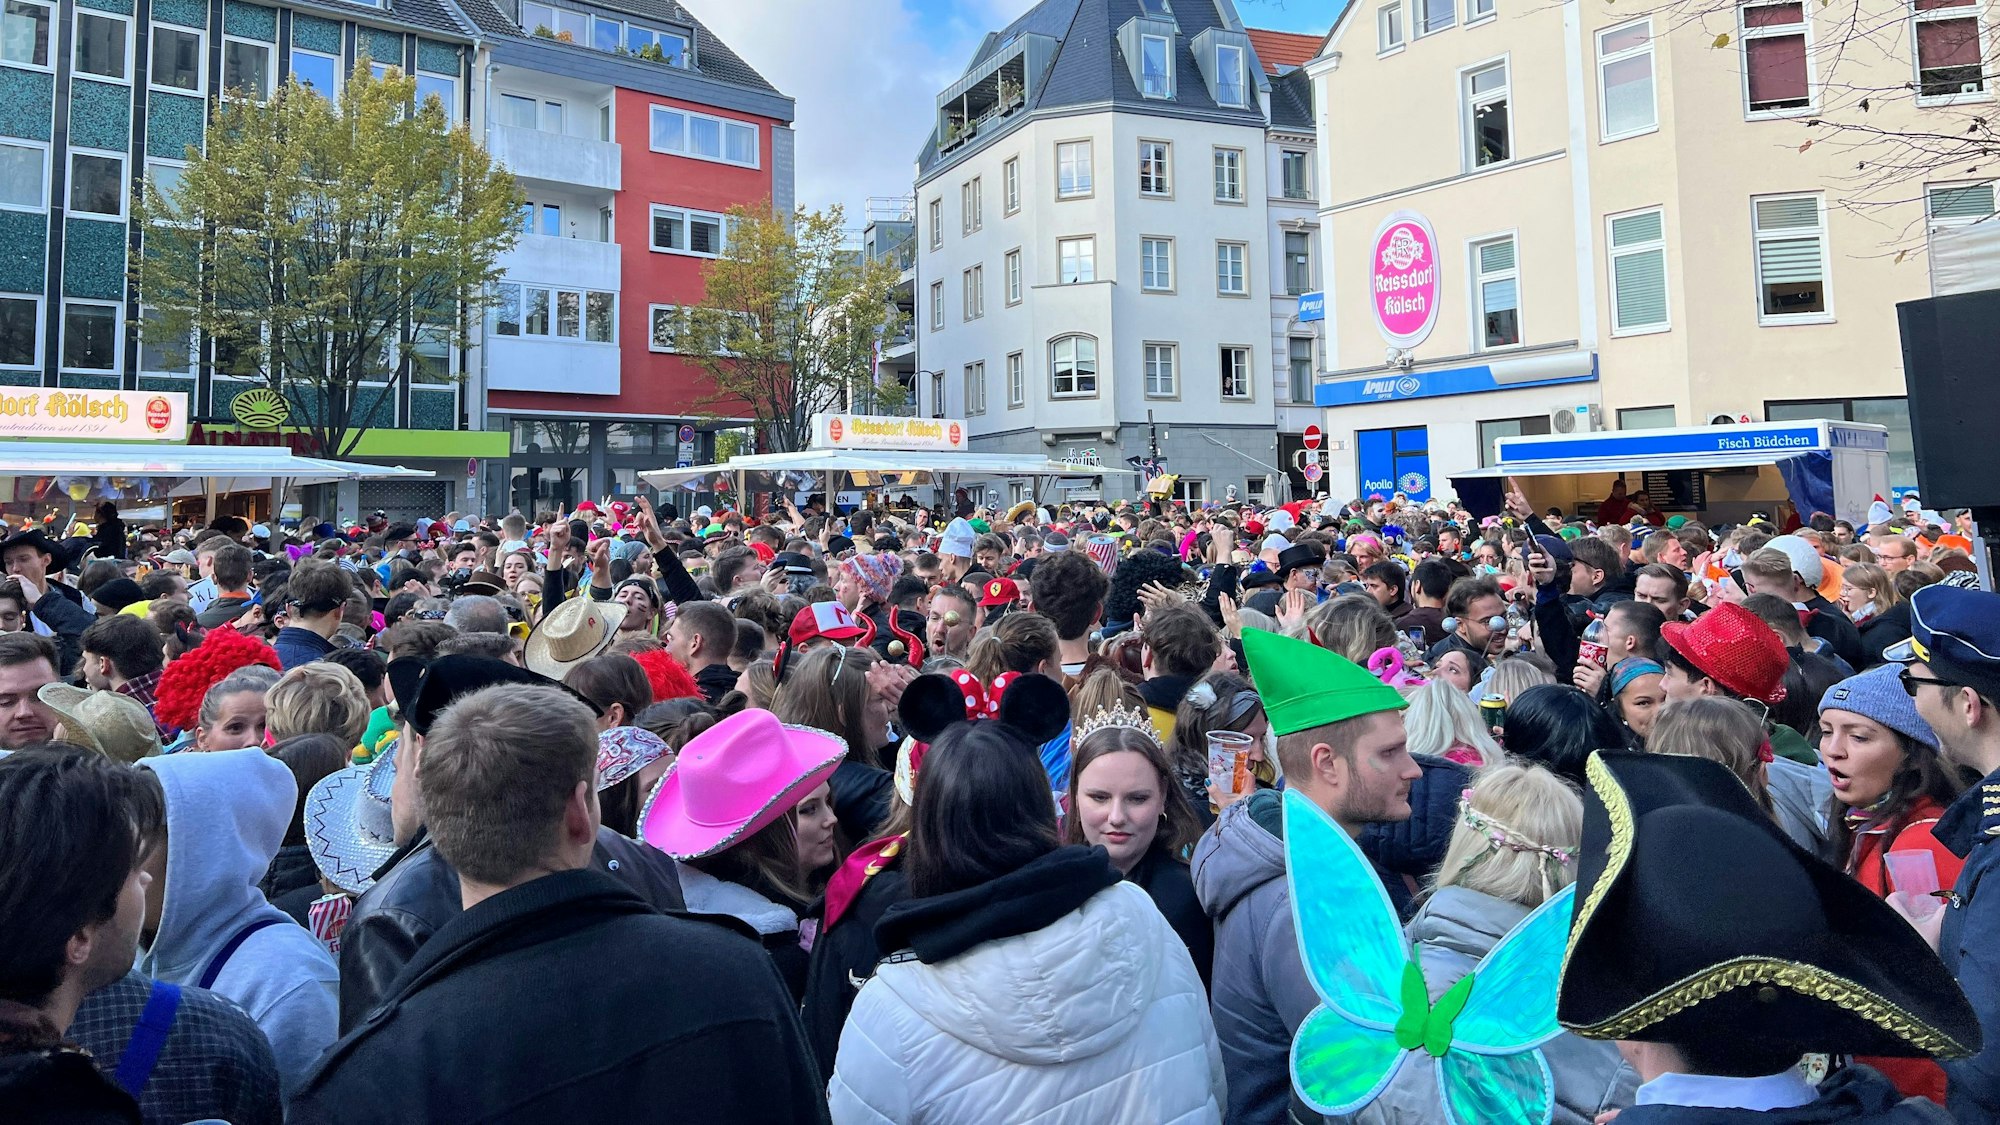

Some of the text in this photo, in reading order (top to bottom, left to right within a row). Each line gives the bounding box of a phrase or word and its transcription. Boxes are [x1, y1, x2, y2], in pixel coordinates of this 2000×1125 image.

[1375, 264, 1433, 293] Reissdorf
[1384, 291, 1425, 315] Kölsch
[1362, 380, 1395, 395] APOLLO
[44, 391, 129, 424] Kölsch
[1718, 434, 1810, 449] Fisch Büdchen
[1365, 479, 1393, 492] Apollo
